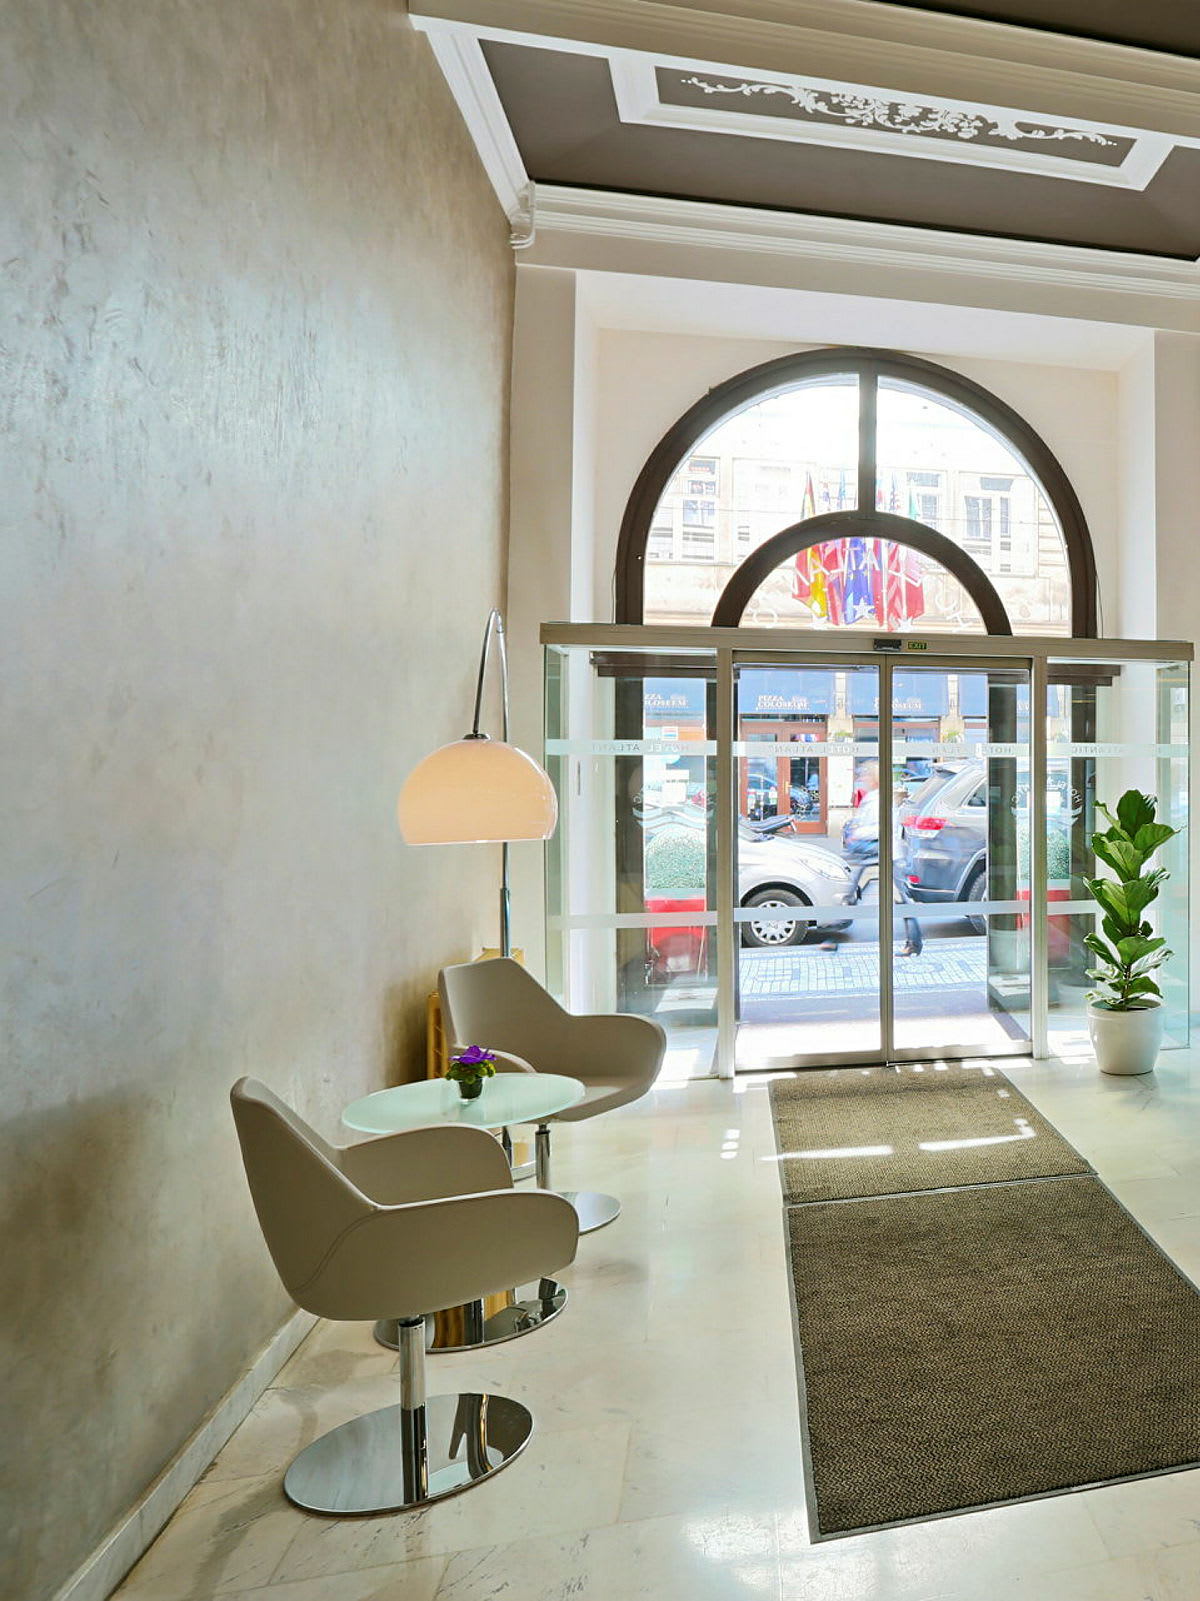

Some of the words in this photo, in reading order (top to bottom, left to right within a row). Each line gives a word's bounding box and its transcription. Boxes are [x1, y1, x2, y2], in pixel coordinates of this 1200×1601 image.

[908, 642, 926, 650] EXIT
[758, 694, 784, 702] PIZZA
[757, 701, 808, 710] COLOSEUM
